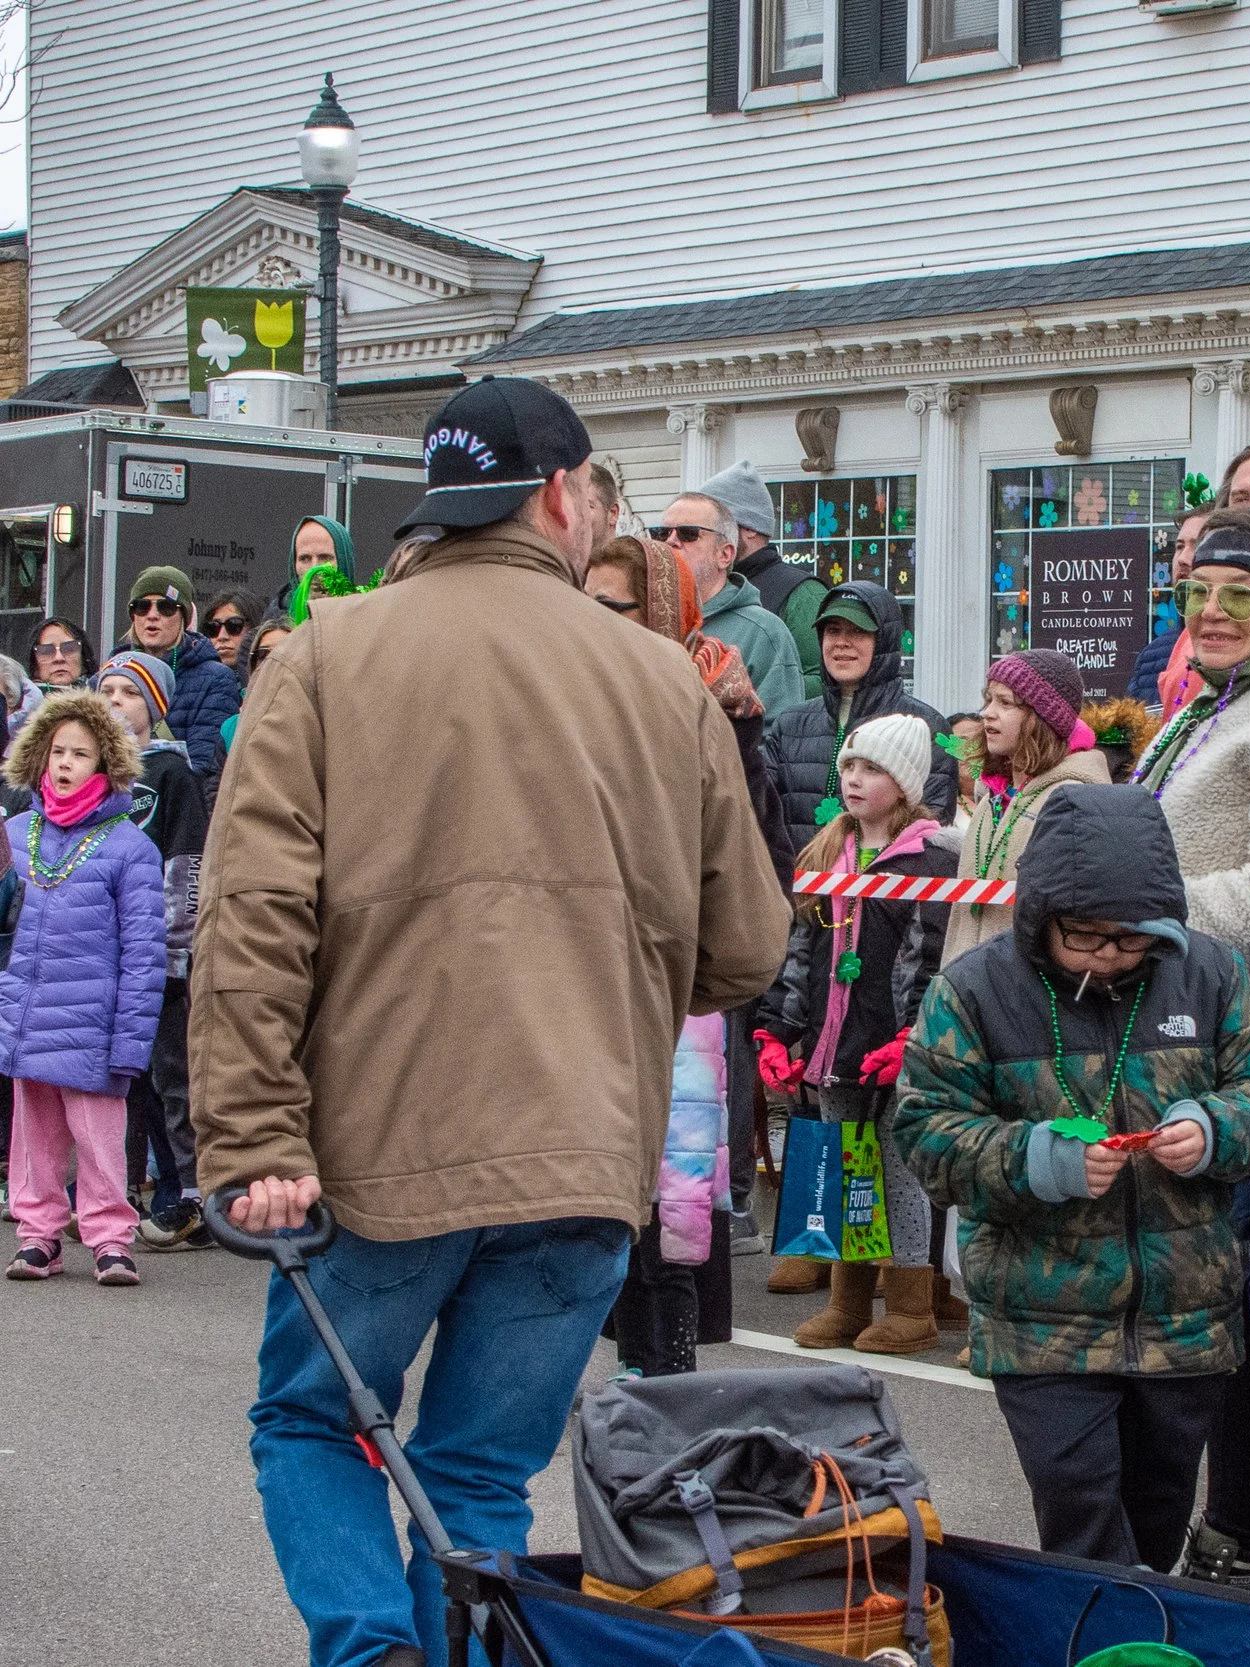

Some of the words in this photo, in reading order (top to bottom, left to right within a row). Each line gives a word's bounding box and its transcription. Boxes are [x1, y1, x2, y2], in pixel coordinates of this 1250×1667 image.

[132, 471, 173, 491] 406725
[187, 538, 228, 563] Johnny
[230, 541, 255, 565] Boys
[1043, 559, 1133, 582] ROMNEY
[1043, 590, 1132, 604] BROWN
[1042, 618, 1082, 628] CANDLE
[1083, 617, 1133, 628] COMPANY
[1057, 638, 1096, 653] CREATE
[1077, 653, 1116, 669] CANDLE
[128, 795, 153, 814] OLTS
[1168, 1015, 1185, 1024] THE
